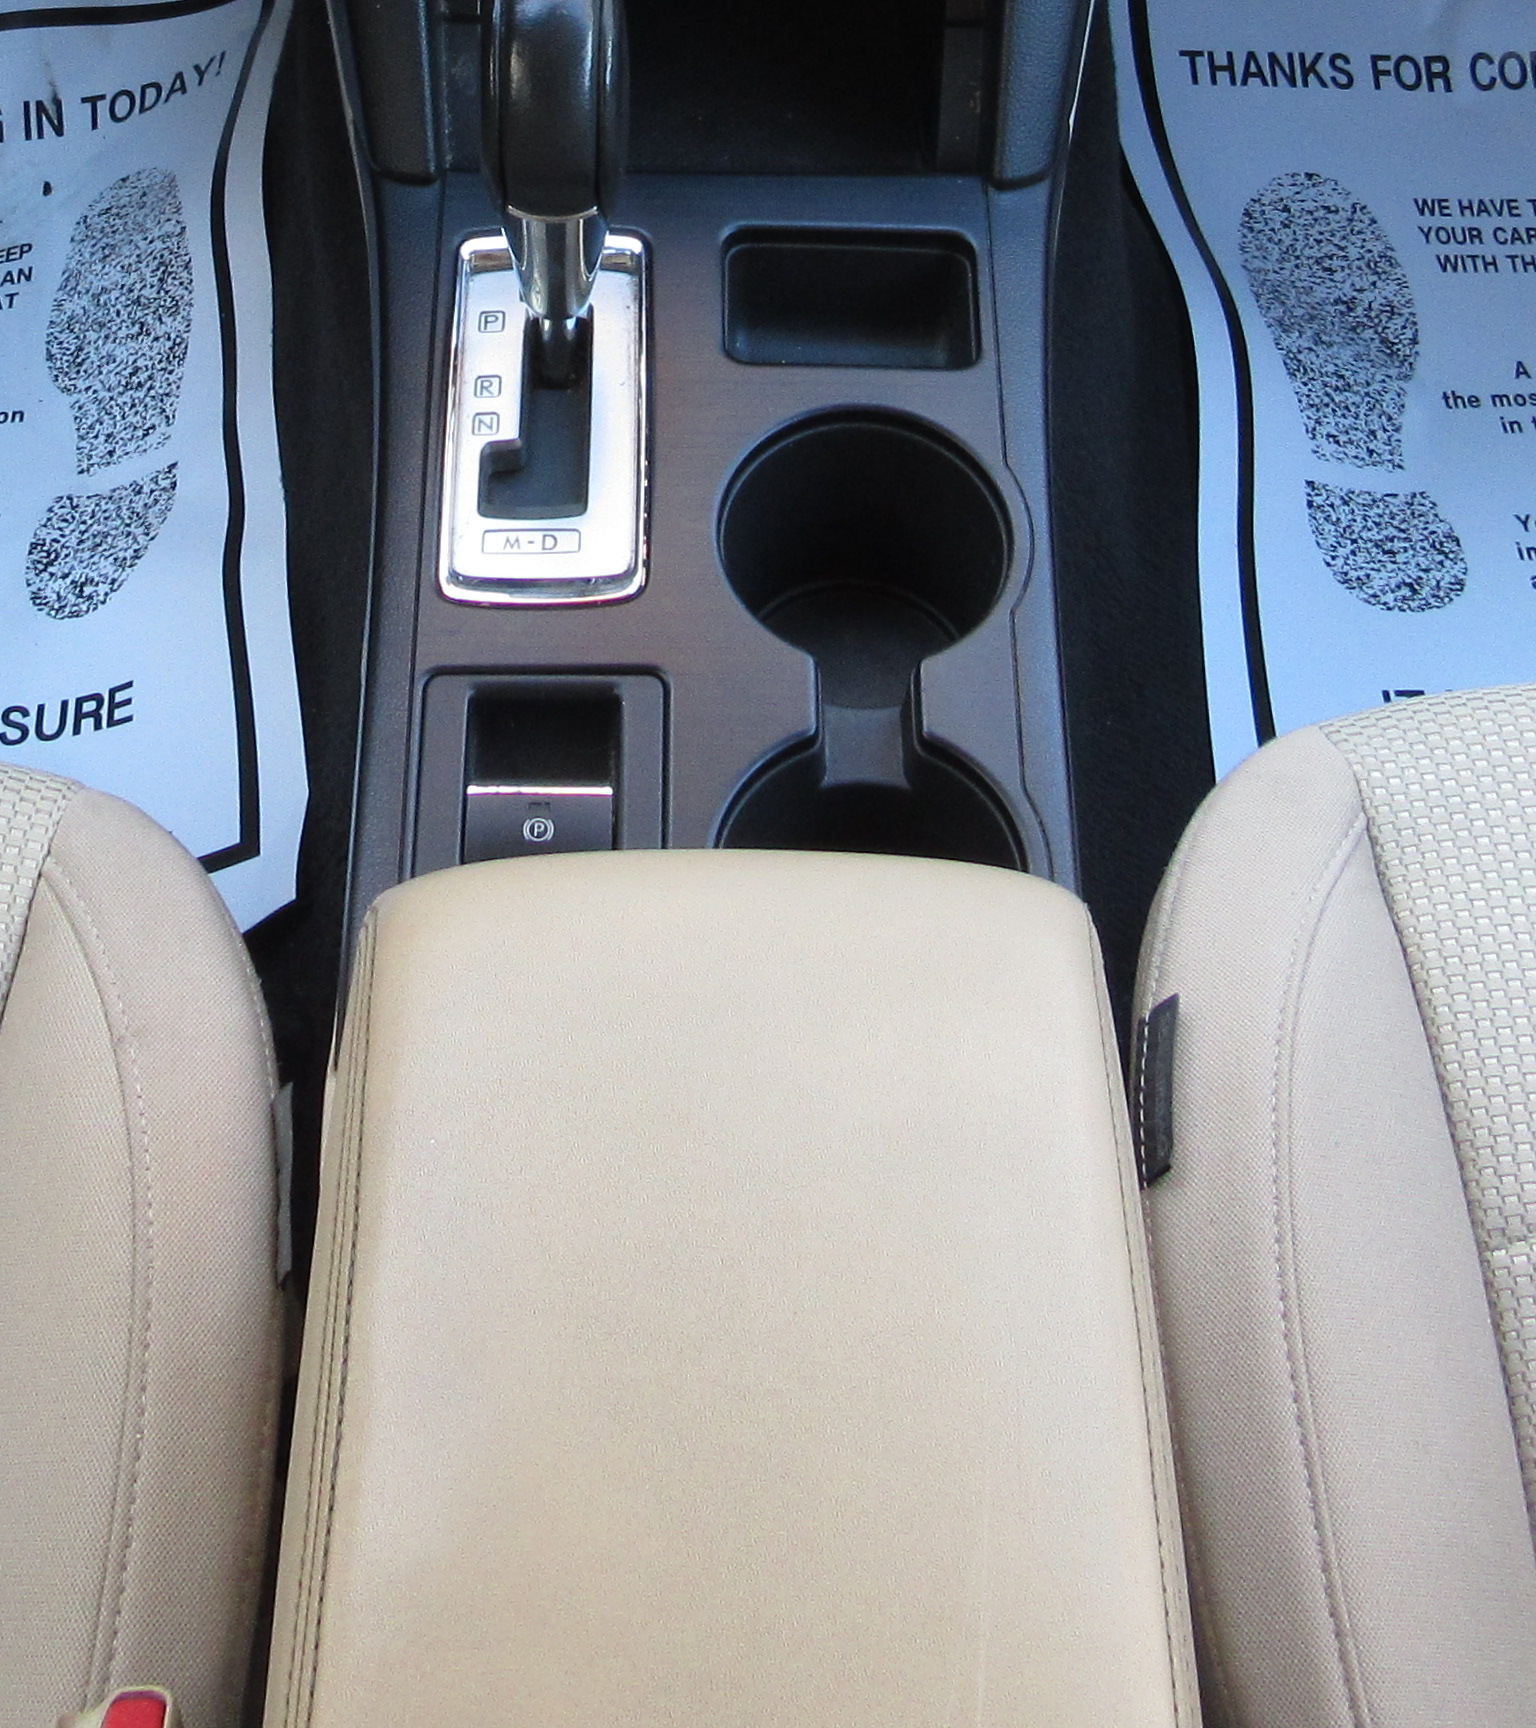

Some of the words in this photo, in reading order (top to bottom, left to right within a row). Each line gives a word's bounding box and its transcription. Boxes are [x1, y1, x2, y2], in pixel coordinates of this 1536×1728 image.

[1178, 50, 1355, 90] THANKS
[1370, 54, 1453, 93] FOR
[23, 99, 64, 141] IN
[81, 51, 227, 130] TODAY!
[1414, 198, 1452, 217] WE
[1459, 198, 1522, 218] HAVE
[1418, 225, 1483, 245] YOUR
[1436, 254, 1498, 273] WITH
[1514, 360, 1532, 379] A
[1442, 390, 1481, 410] the
[1499, 416, 1523, 435] in
